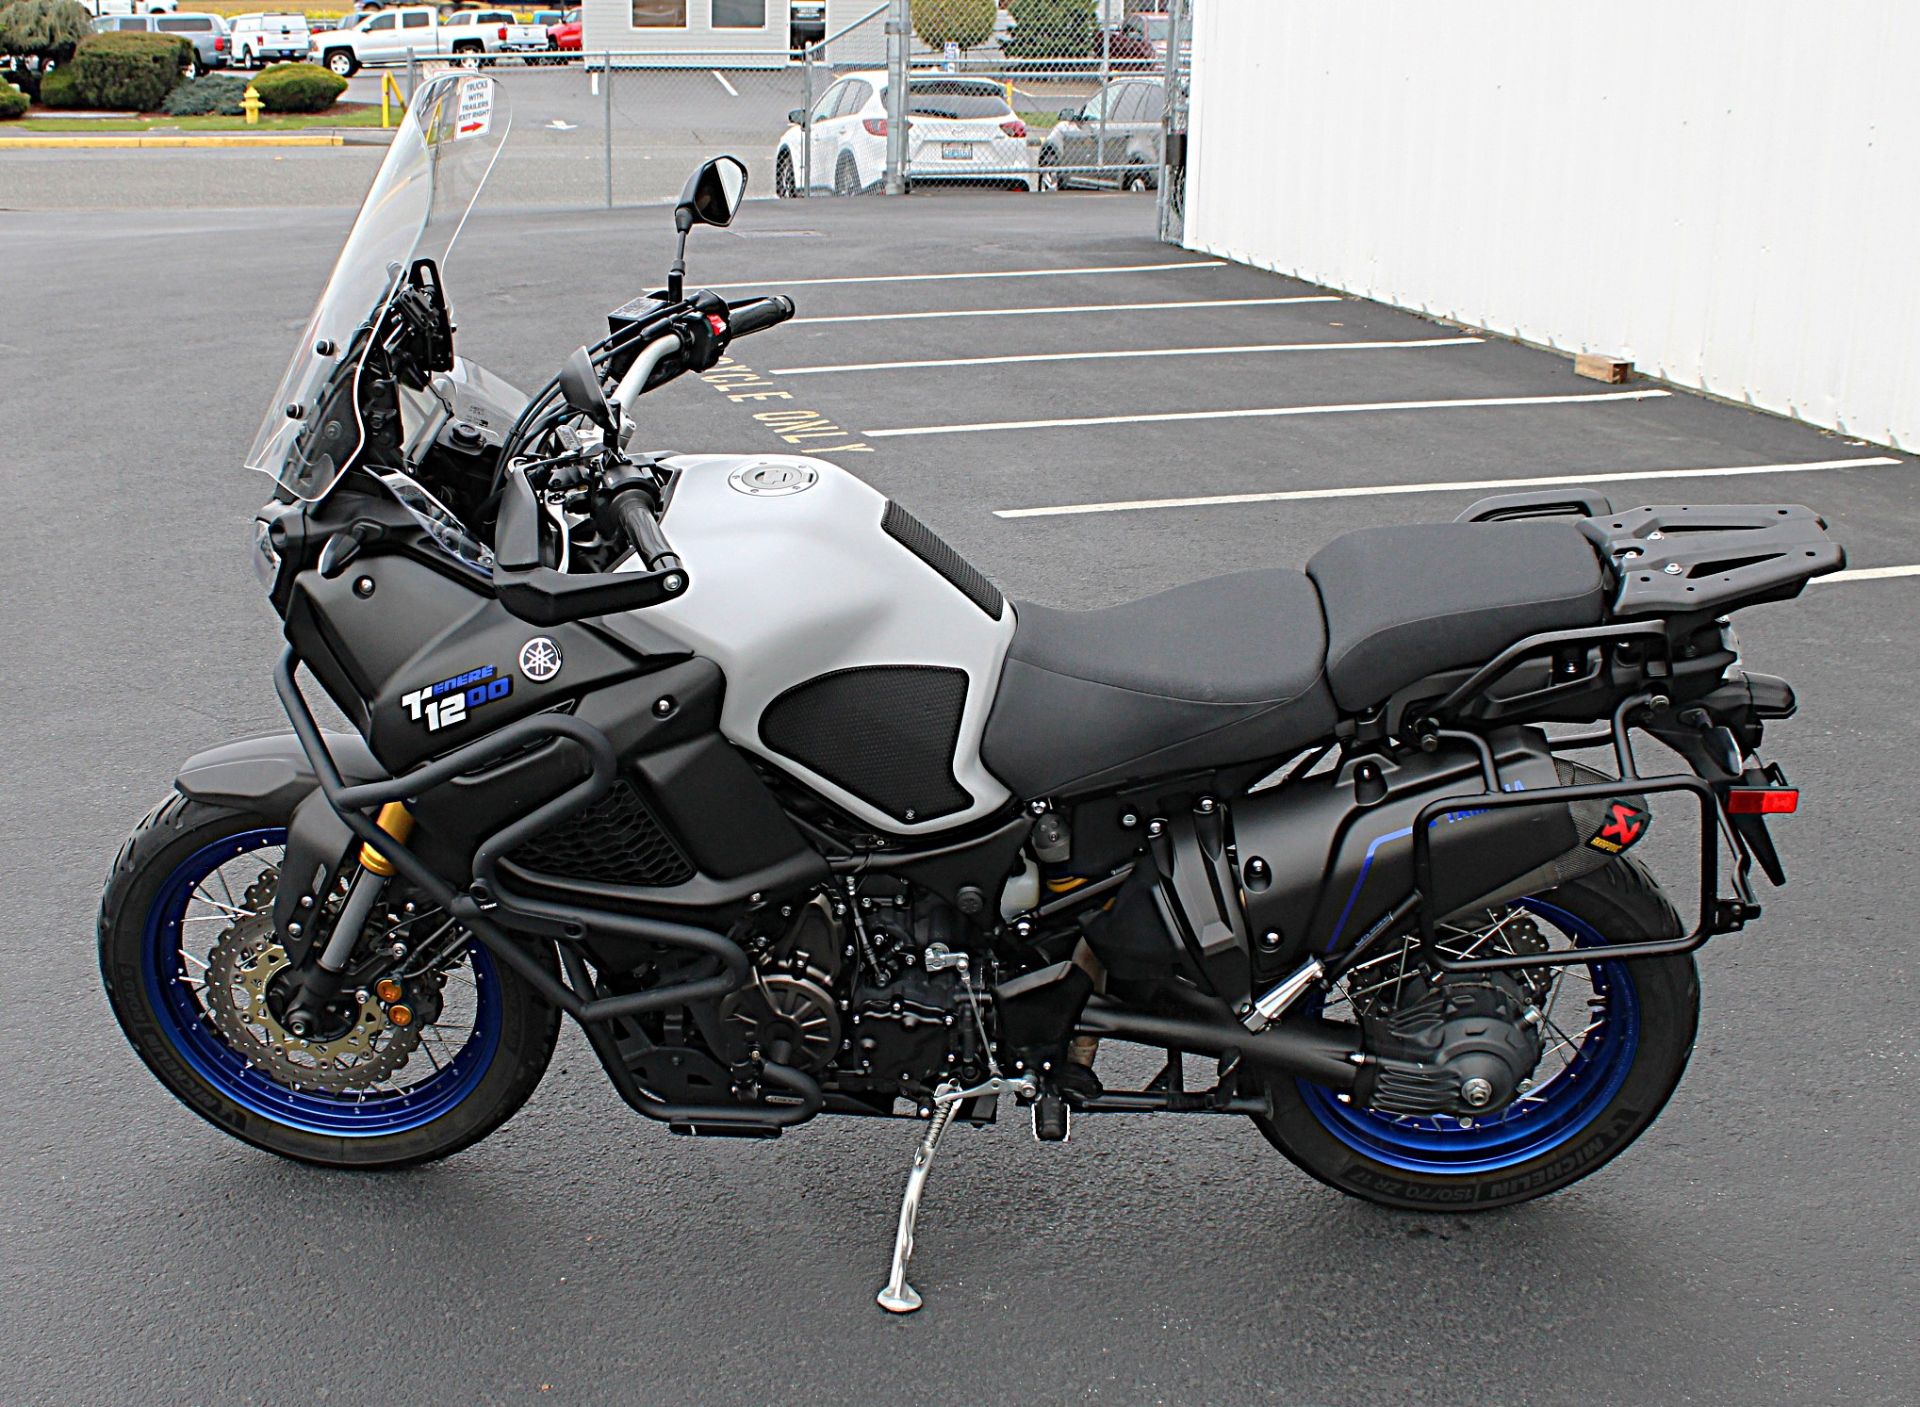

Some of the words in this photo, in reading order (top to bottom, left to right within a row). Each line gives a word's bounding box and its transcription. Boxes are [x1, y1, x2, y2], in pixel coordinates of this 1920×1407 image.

[466, 80, 488, 91] TRUCKS
[468, 92, 484, 101] WITH
[462, 100, 489, 111] TRAILERS
[459, 112, 472, 121] EXIT
[472, 109, 490, 118] RIGHT
[752, 411, 875, 453] ONLY
[425, 677, 509, 731] 1200
[122, 979, 147, 1022] ROAD
[144, 1033, 222, 1112] MICHELIN
[1490, 1138, 1605, 1198] MICHELIN
[1350, 1171, 1370, 1186] 17
[1374, 1177, 1401, 1194] ZR
[1407, 1183, 1474, 1201] 150/70
